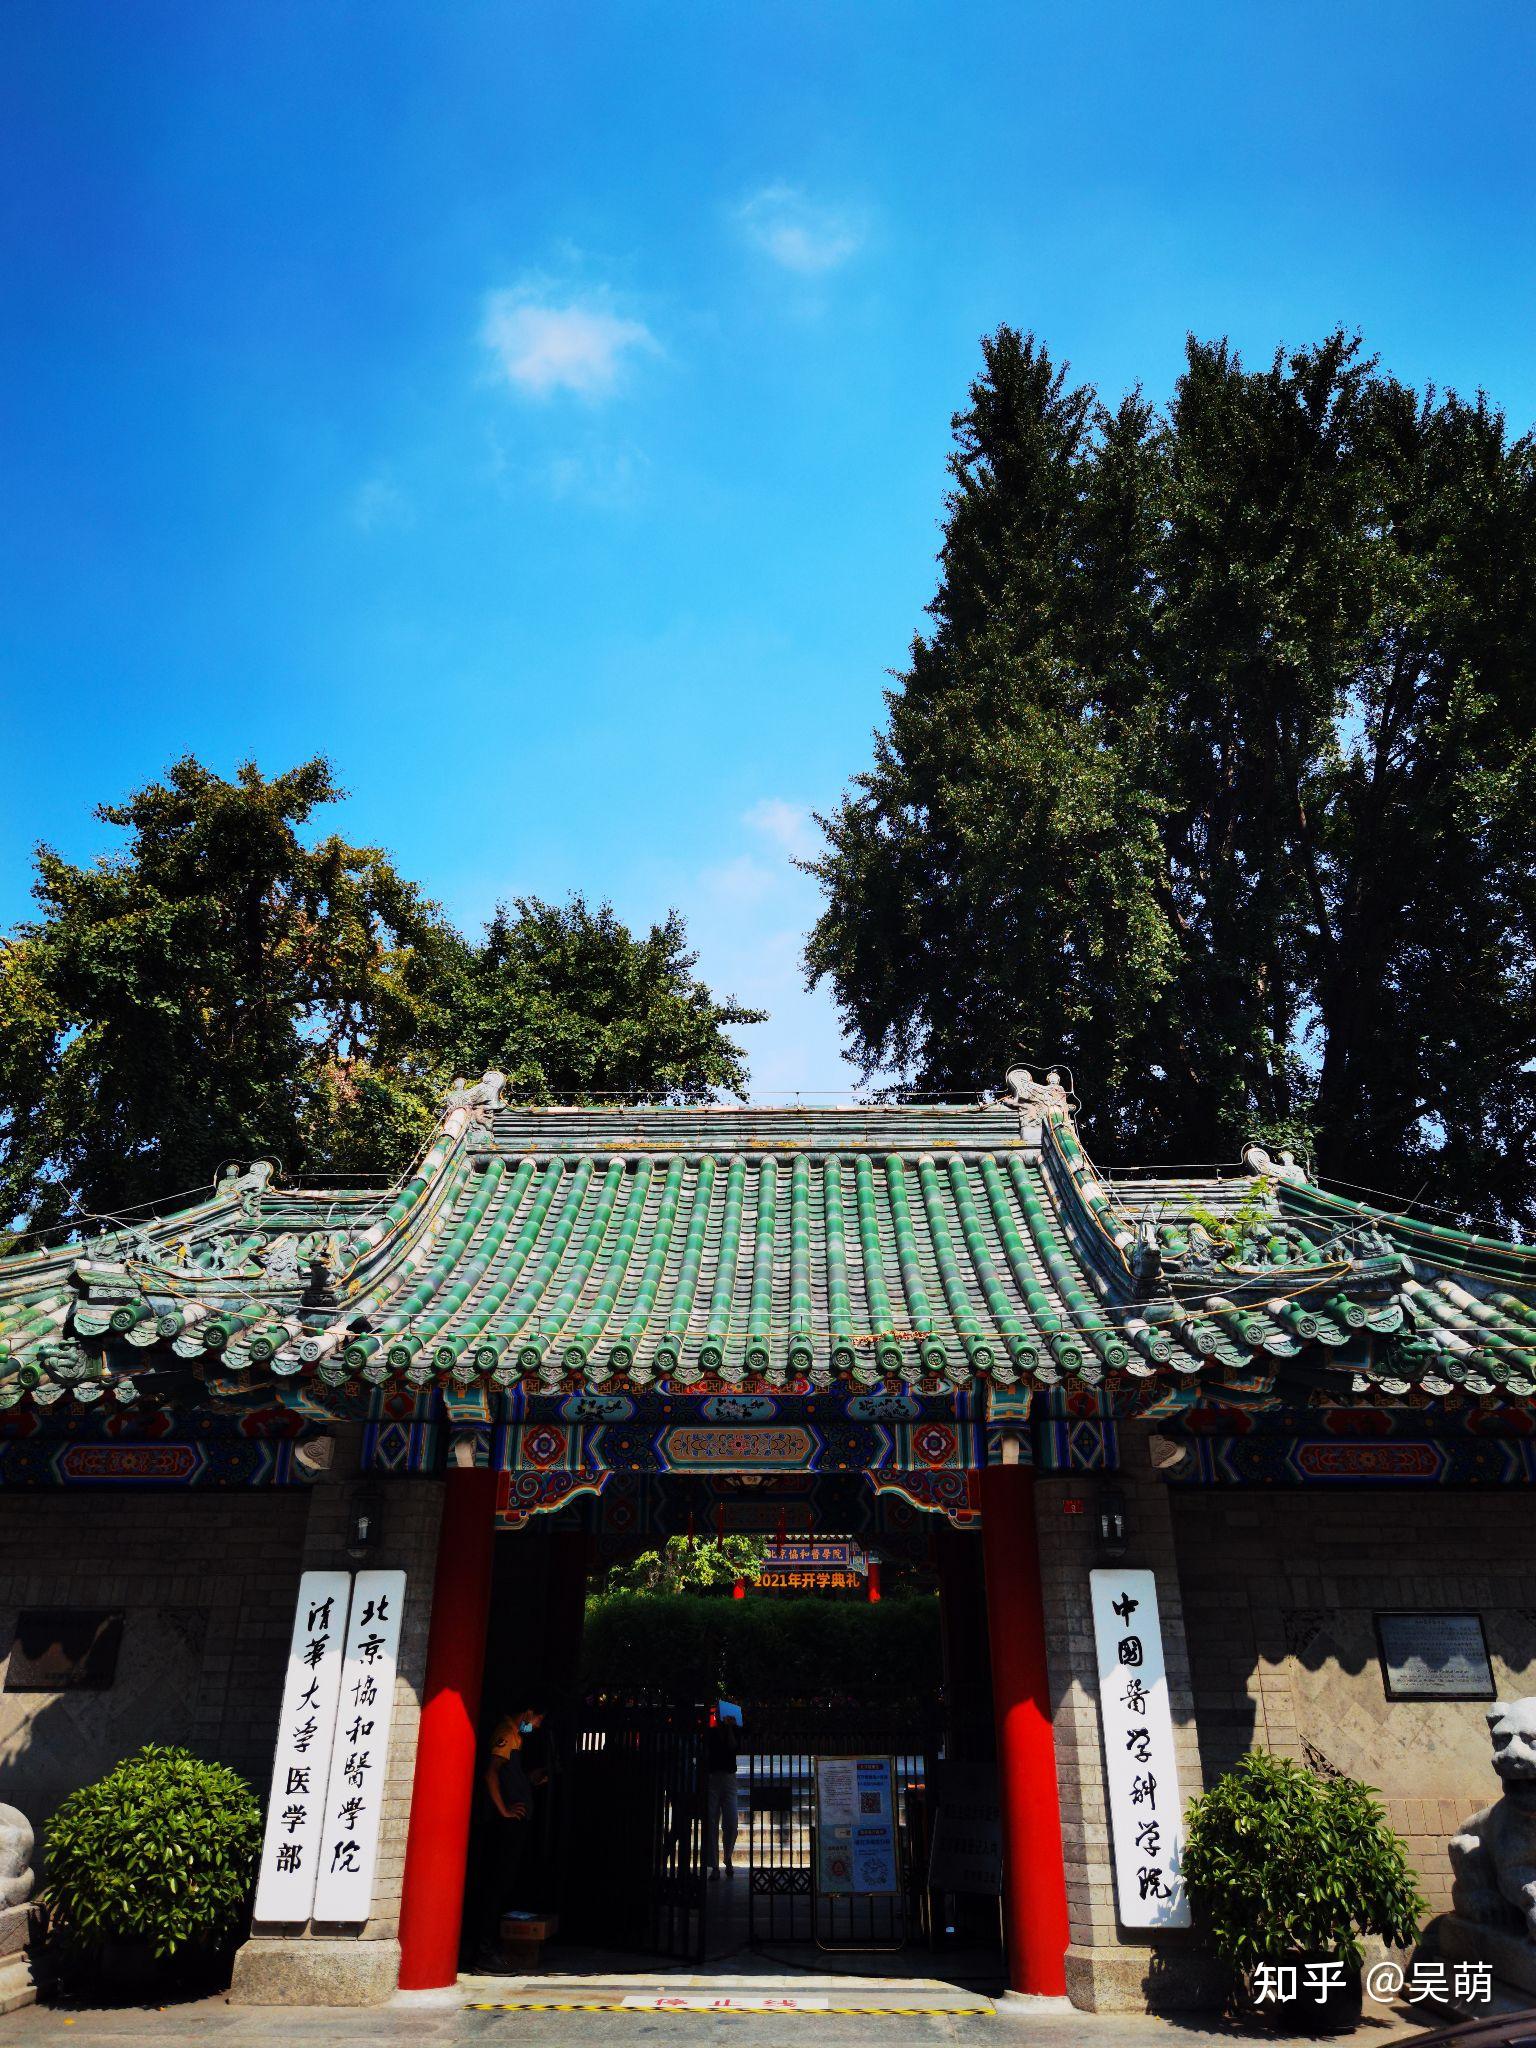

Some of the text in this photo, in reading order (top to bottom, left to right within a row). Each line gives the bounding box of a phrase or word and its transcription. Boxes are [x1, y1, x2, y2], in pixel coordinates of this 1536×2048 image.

[754, 1573, 860, 1588] 2021年开学典礼
[654, 1998, 797, 2008] 停止线
